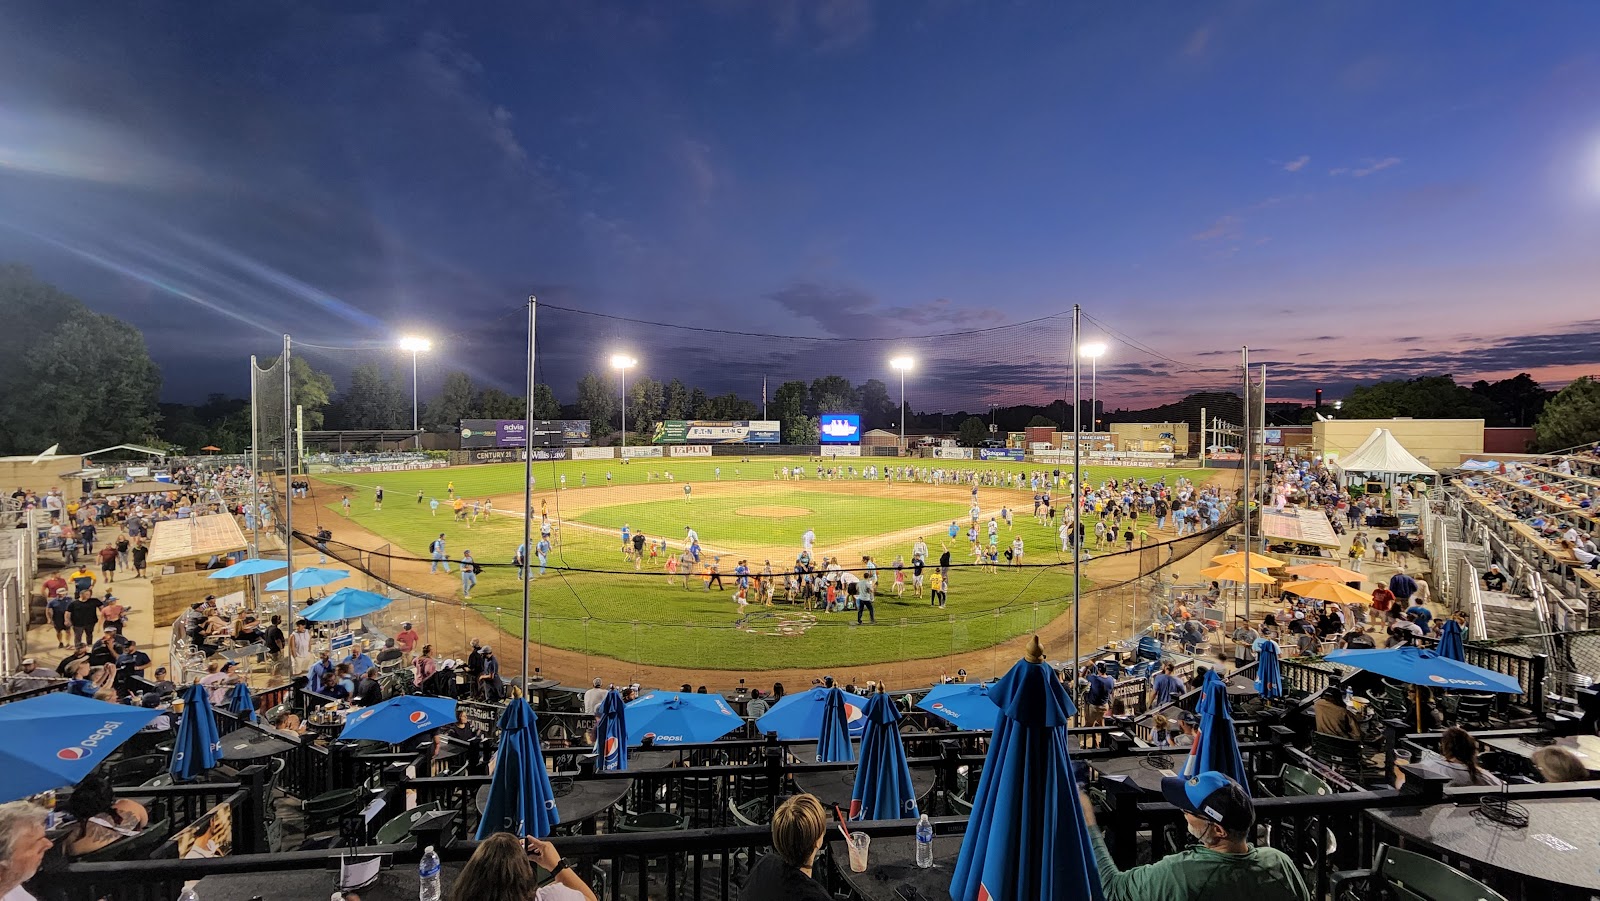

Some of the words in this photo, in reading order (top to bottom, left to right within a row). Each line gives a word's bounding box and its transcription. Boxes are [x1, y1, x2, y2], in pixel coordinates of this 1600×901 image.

[476, 451, 505, 459] CENTURY
[674, 446, 709, 454] TAPLIN
[1448, 678, 1487, 686] pepsi
[1113, 683, 1144, 697] ACCESSIBLE
[941, 707, 960, 719] pepsi
[80, 720, 124, 747] pepsi
